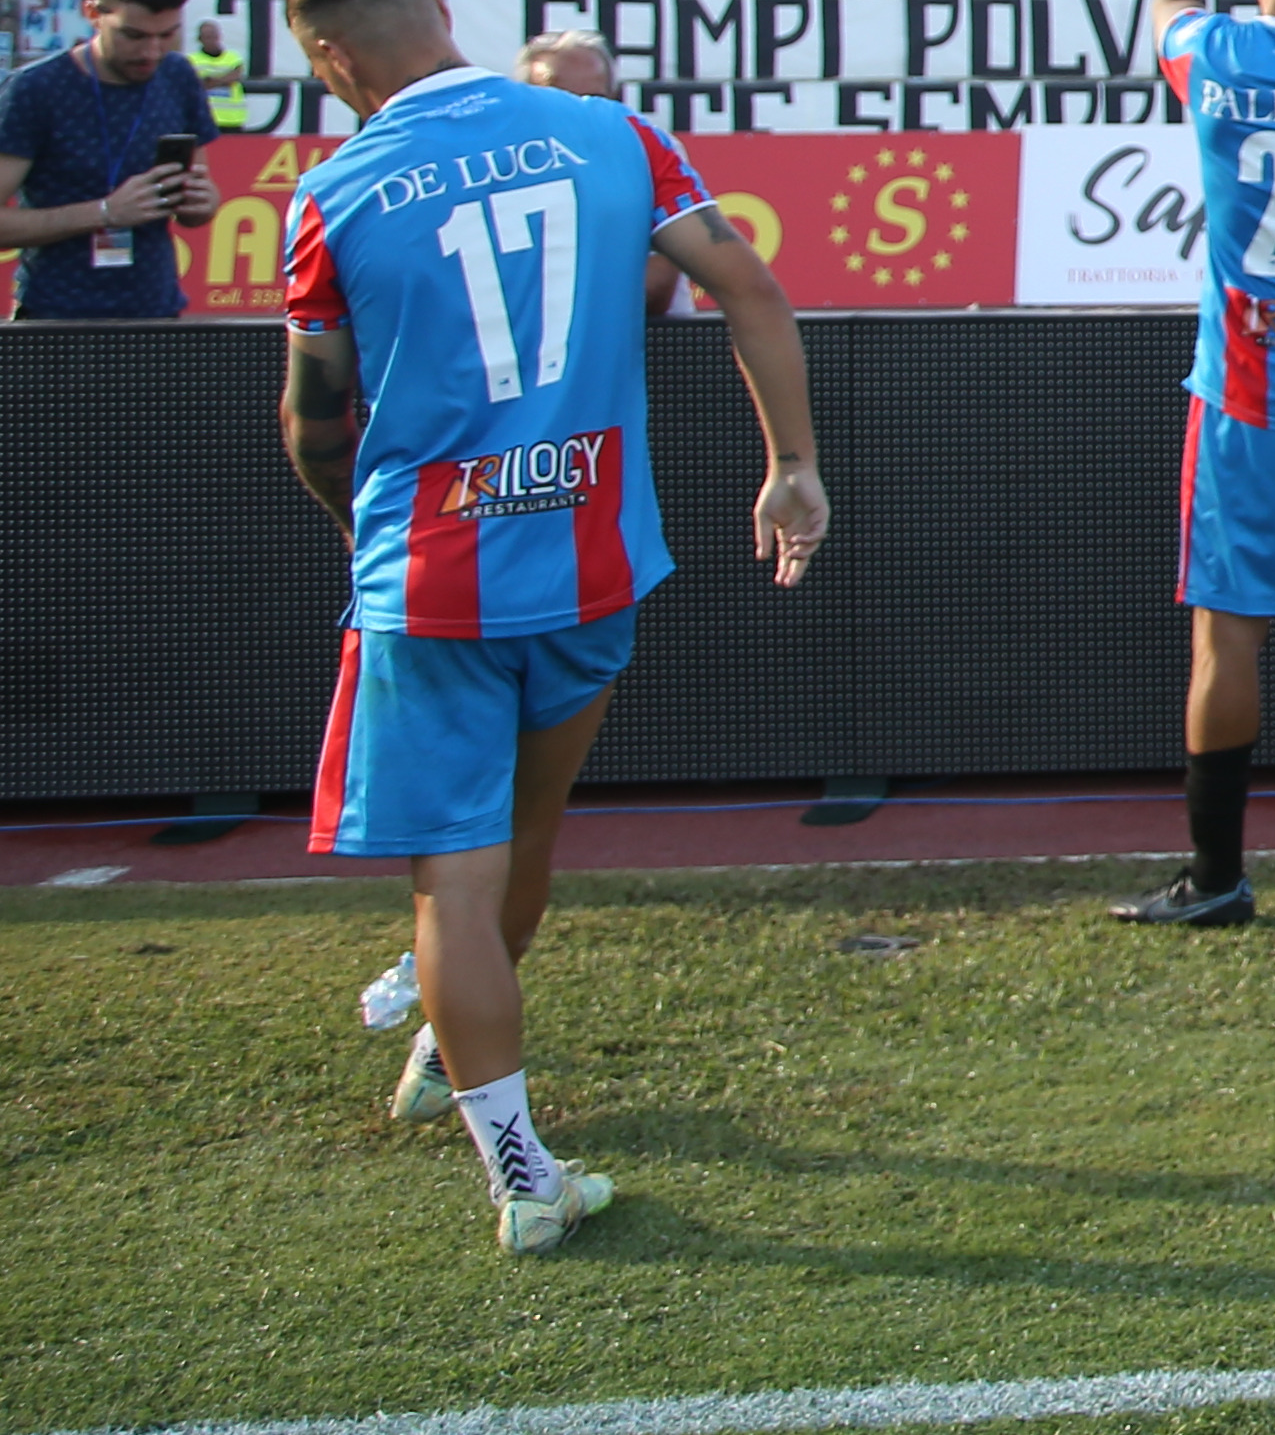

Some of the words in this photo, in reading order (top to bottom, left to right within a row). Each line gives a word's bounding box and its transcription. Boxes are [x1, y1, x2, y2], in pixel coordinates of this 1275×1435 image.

[373, 163, 449, 215] DE
[454, 137, 589, 190] LUCA
[866, 176, 930, 256] S
[437, 177, 578, 404] 17
[458, 433, 606, 507] TRILOGY
[473, 494, 577, 517] RESTAURANT
